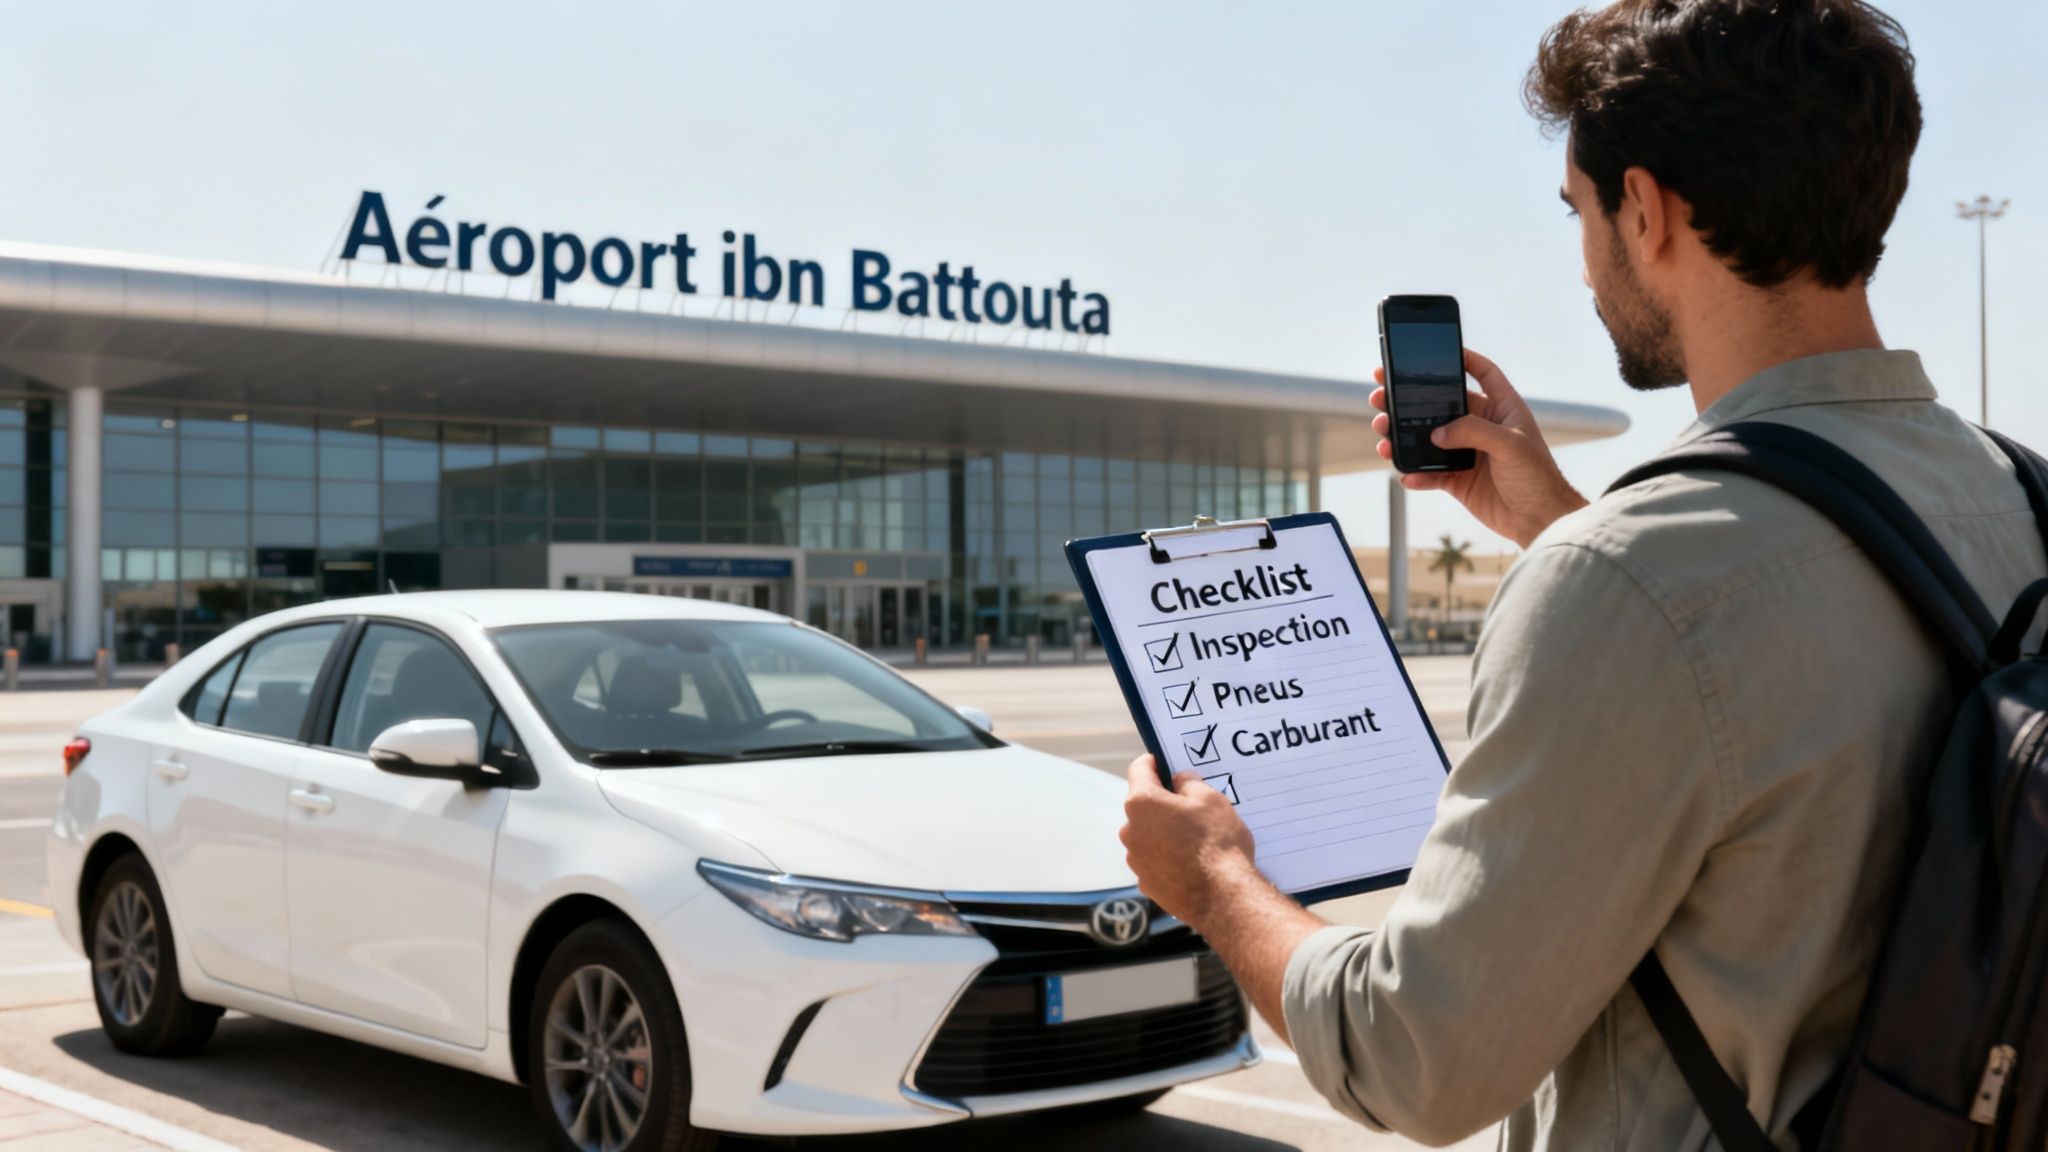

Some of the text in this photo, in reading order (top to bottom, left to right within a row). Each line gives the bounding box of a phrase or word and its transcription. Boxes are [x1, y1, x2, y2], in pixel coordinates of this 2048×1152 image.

[340, 190, 1111, 336] Aéroport ibn Battouta
[1151, 564, 1312, 613] Checklist
[1190, 615, 1350, 661] Inspection
[1211, 677, 1304, 709] Pneus
[1232, 707, 1381, 756] Carburant
